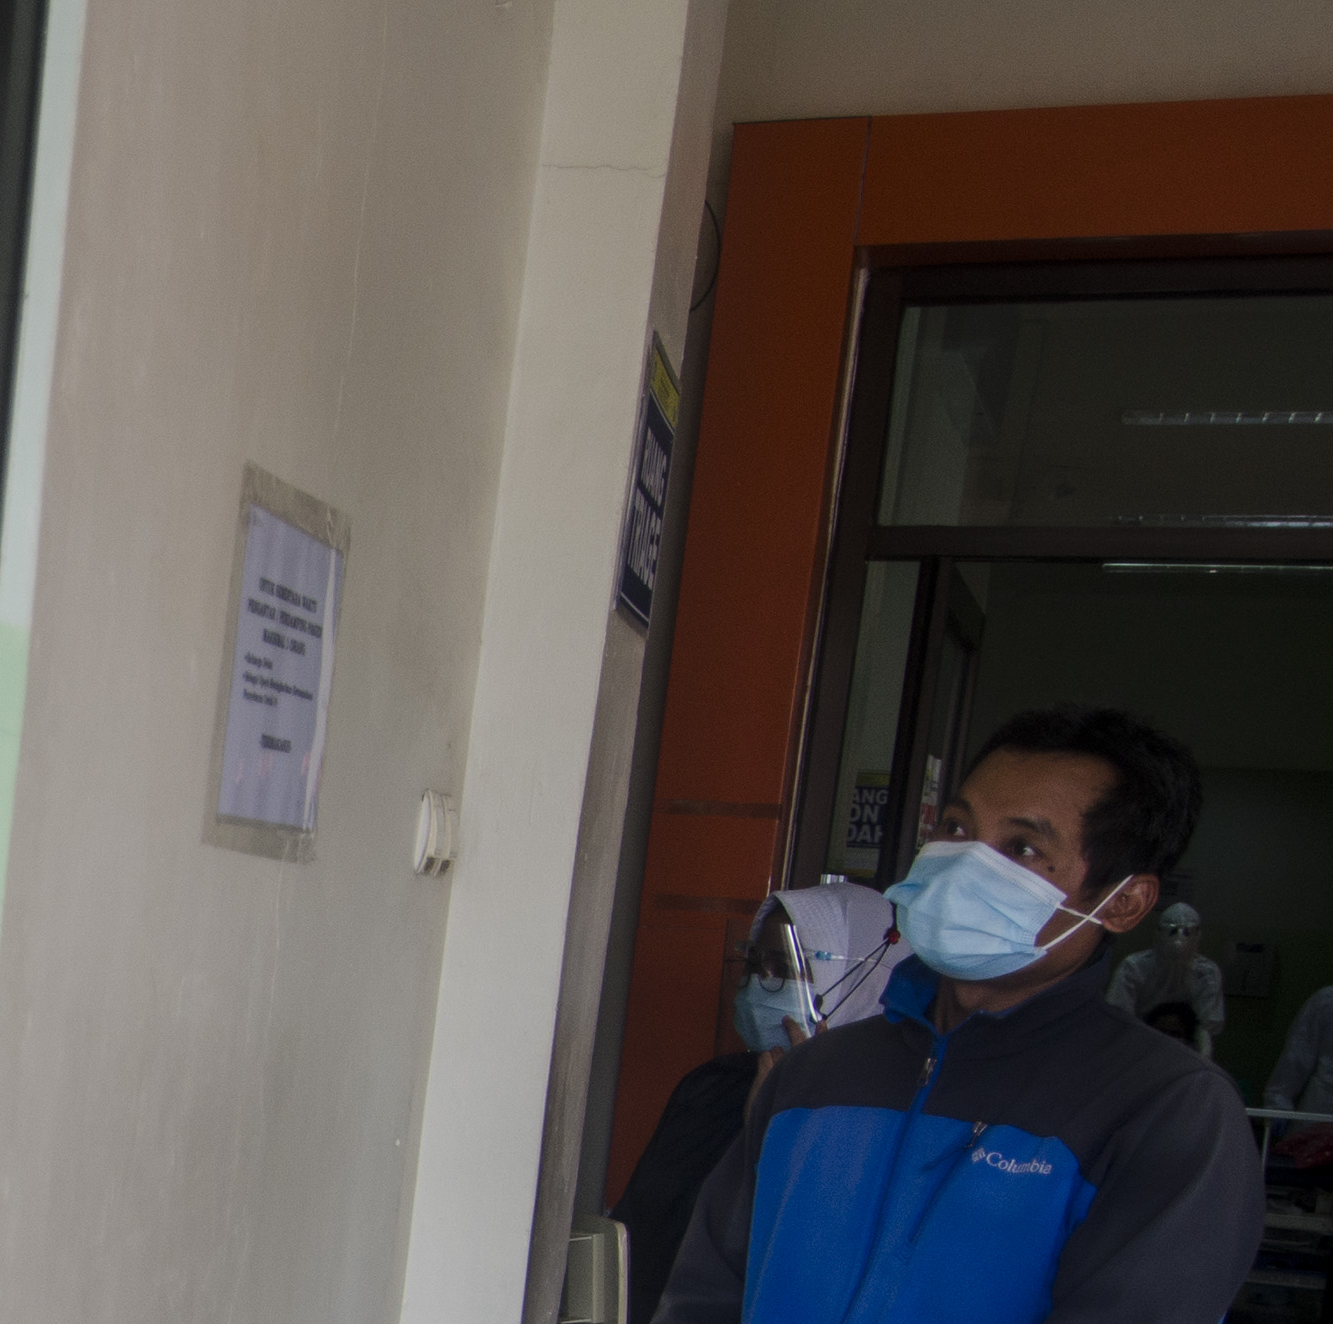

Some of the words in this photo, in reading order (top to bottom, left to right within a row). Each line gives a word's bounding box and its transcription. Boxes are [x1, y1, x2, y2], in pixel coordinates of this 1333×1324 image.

[642, 427, 667, 507] RUANG
[628, 488, 661, 590] TRIAGE
[985, 1151, 1053, 1175] Columbia
